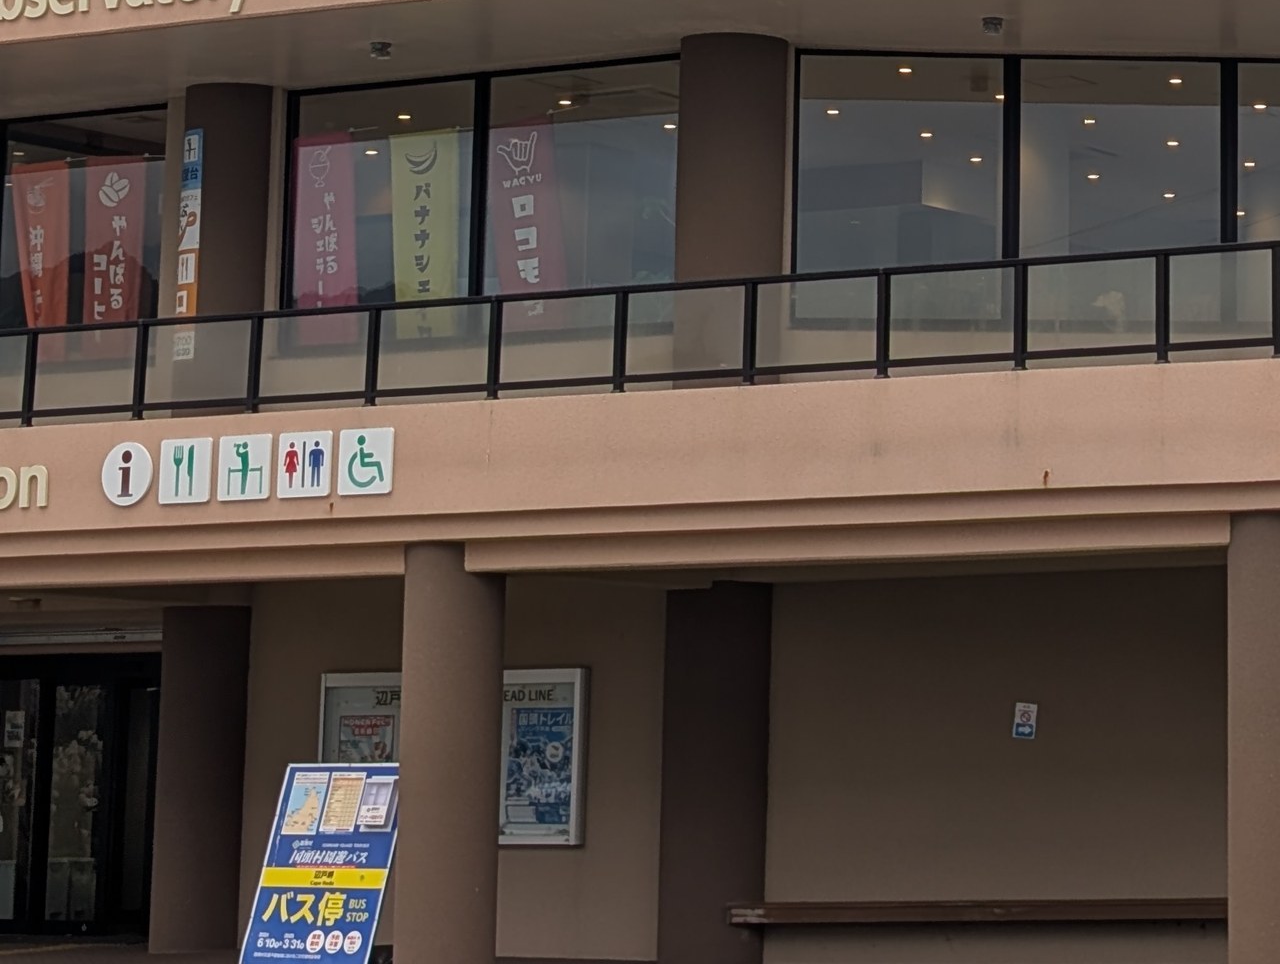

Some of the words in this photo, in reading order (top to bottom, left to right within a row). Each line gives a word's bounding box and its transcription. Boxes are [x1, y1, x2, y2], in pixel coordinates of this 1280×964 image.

[323, 192, 339, 275] やんばる
[109, 215, 127, 310] やんばる
[528, 689, 554, 701] LINE
[261, 891, 347, 927] バス停
[348, 898, 367, 909] BUS
[345, 912, 369, 923] STOP
